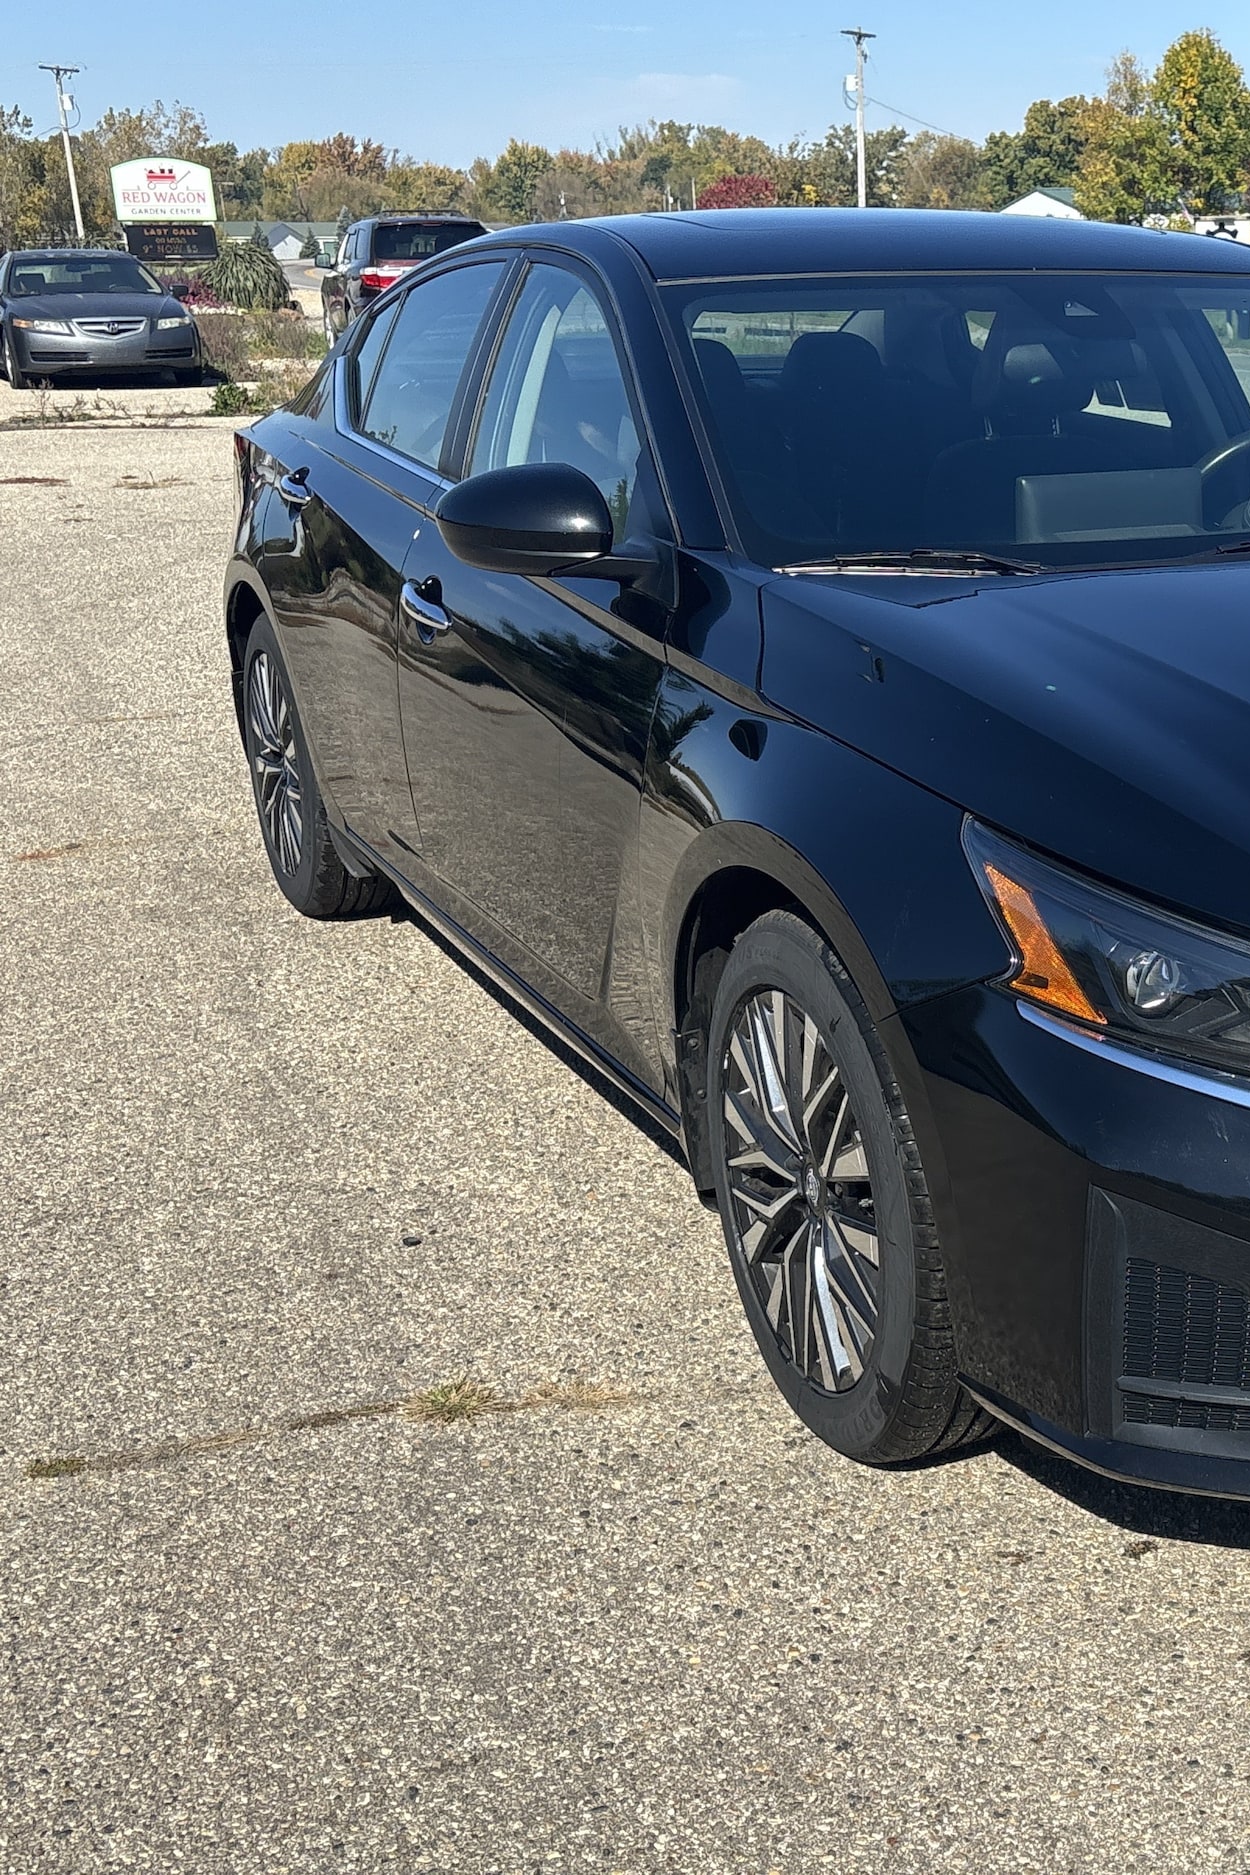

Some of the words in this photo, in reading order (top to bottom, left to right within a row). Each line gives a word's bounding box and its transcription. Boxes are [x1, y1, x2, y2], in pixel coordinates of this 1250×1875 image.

[122, 192, 151, 204] RED
[153, 192, 206, 204] WAGON
[143, 228, 169, 236] LAST
[172, 228, 199, 236] CALL
